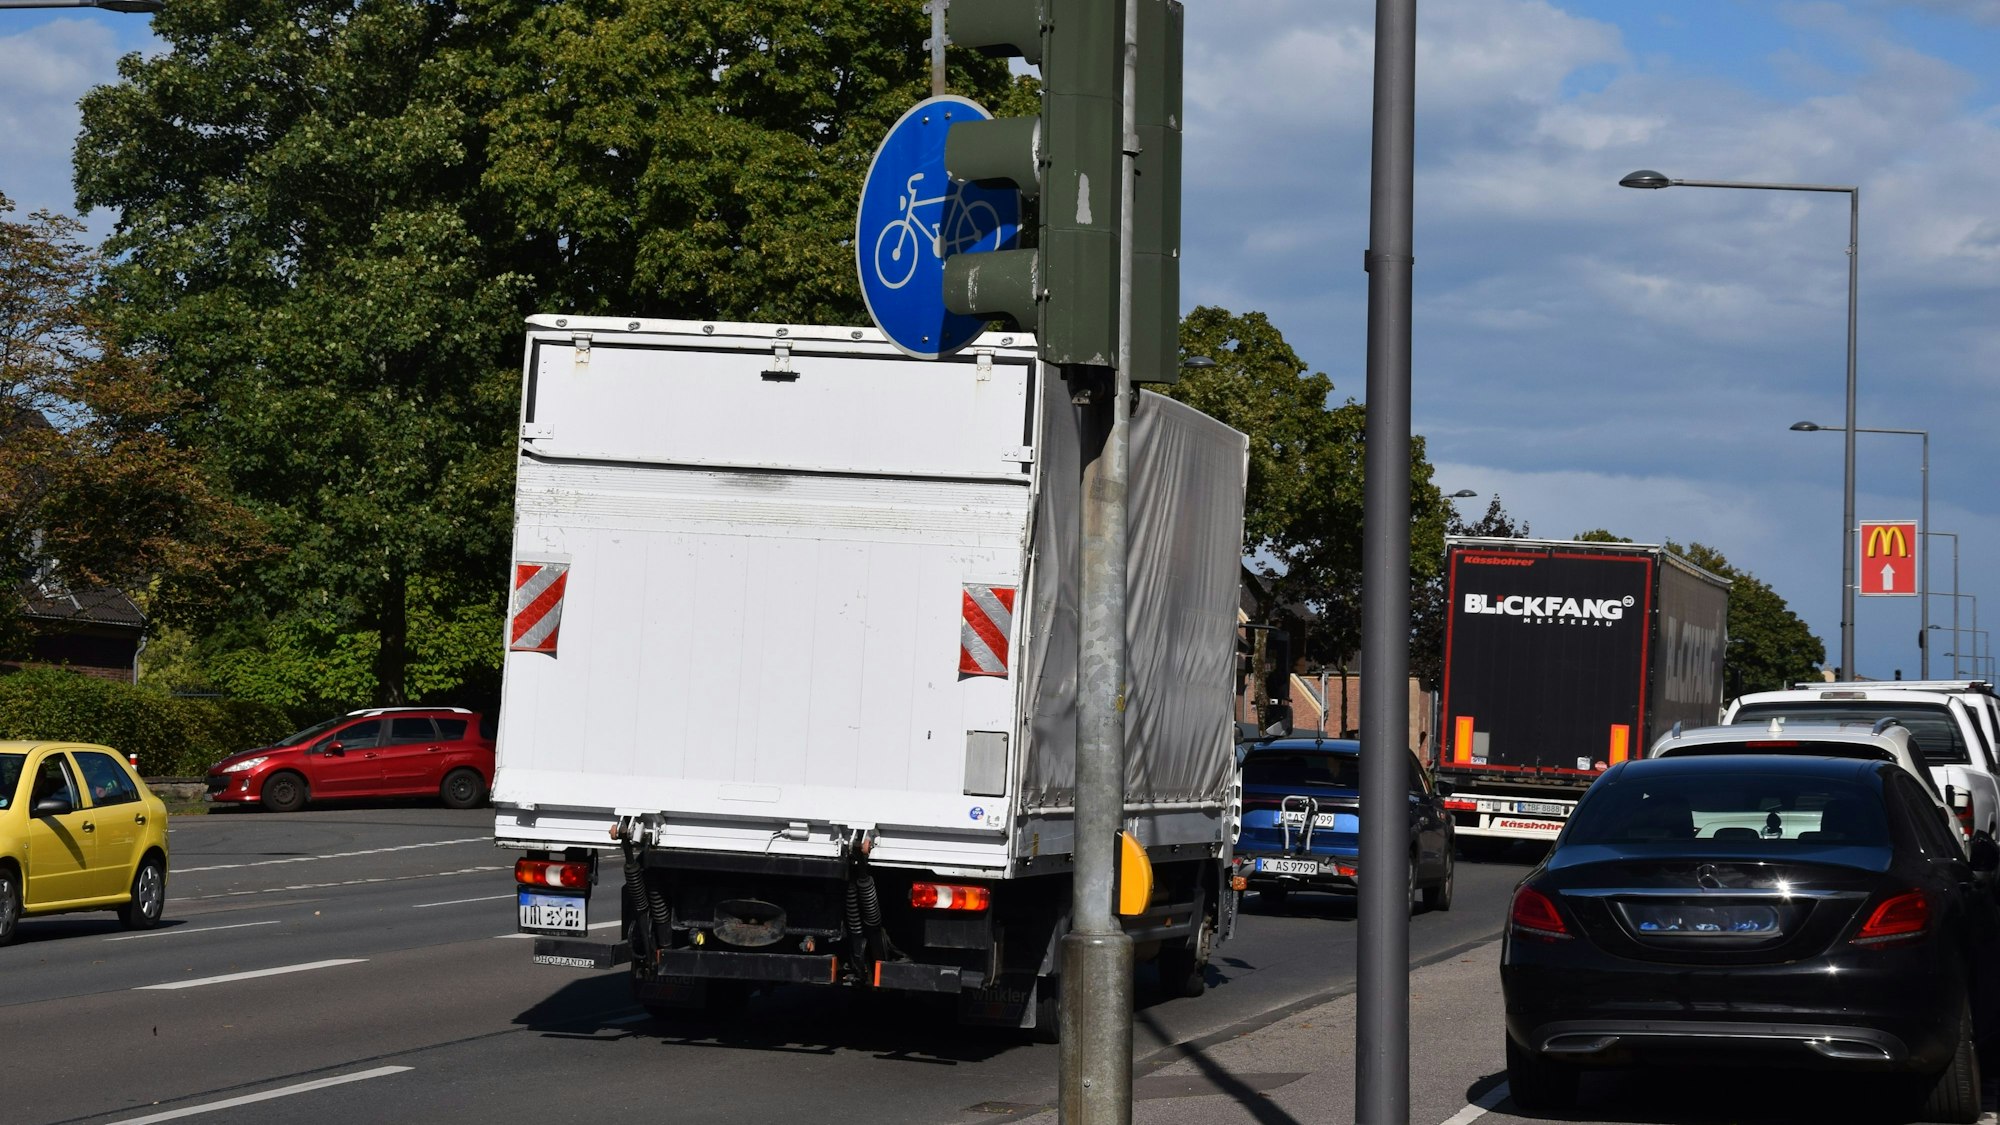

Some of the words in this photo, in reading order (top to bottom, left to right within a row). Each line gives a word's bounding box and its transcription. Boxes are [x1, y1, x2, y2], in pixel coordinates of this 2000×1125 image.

[1463, 555, 1535, 567] Kässbohrer
[1523, 617, 1612, 627] MESSEBAU
[1500, 820, 1564, 831] Kässbohr
[1262, 860, 1269, 870] K
[534, 955, 593, 968] DHOLLANDIA
